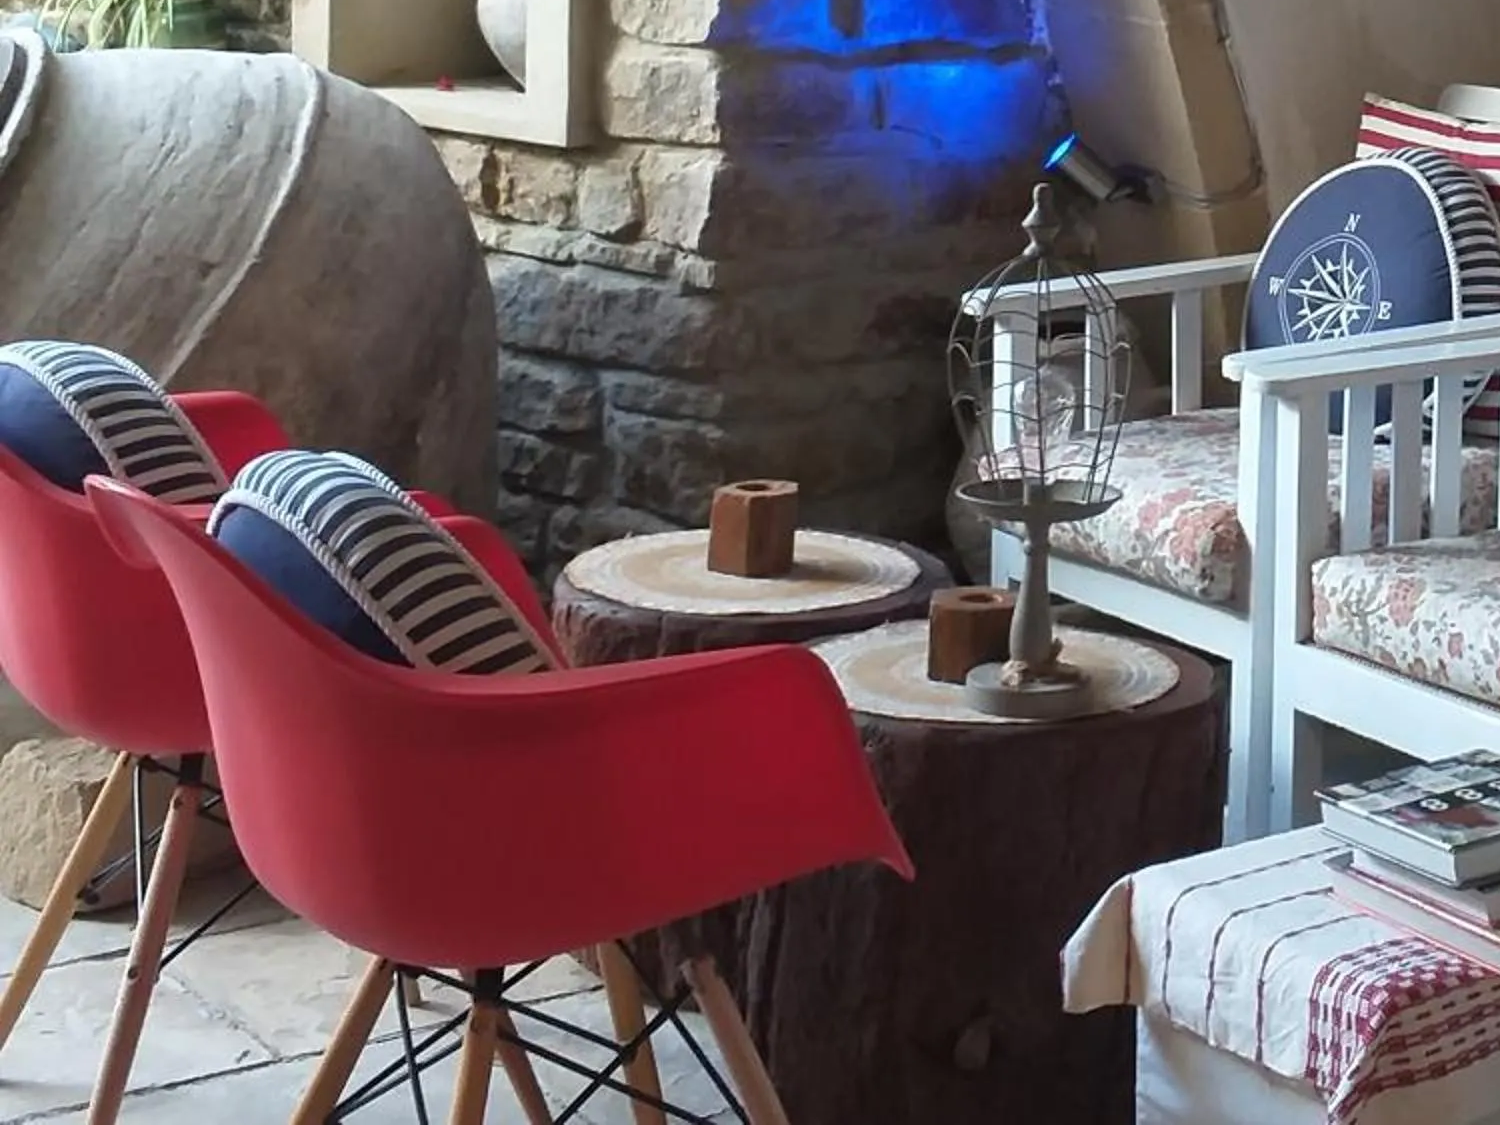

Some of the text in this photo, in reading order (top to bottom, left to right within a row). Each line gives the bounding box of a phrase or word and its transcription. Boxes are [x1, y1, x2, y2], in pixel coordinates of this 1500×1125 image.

[1344, 213, 1360, 232] N
[1269, 276, 1284, 296] W
[1378, 301, 1392, 320] E
